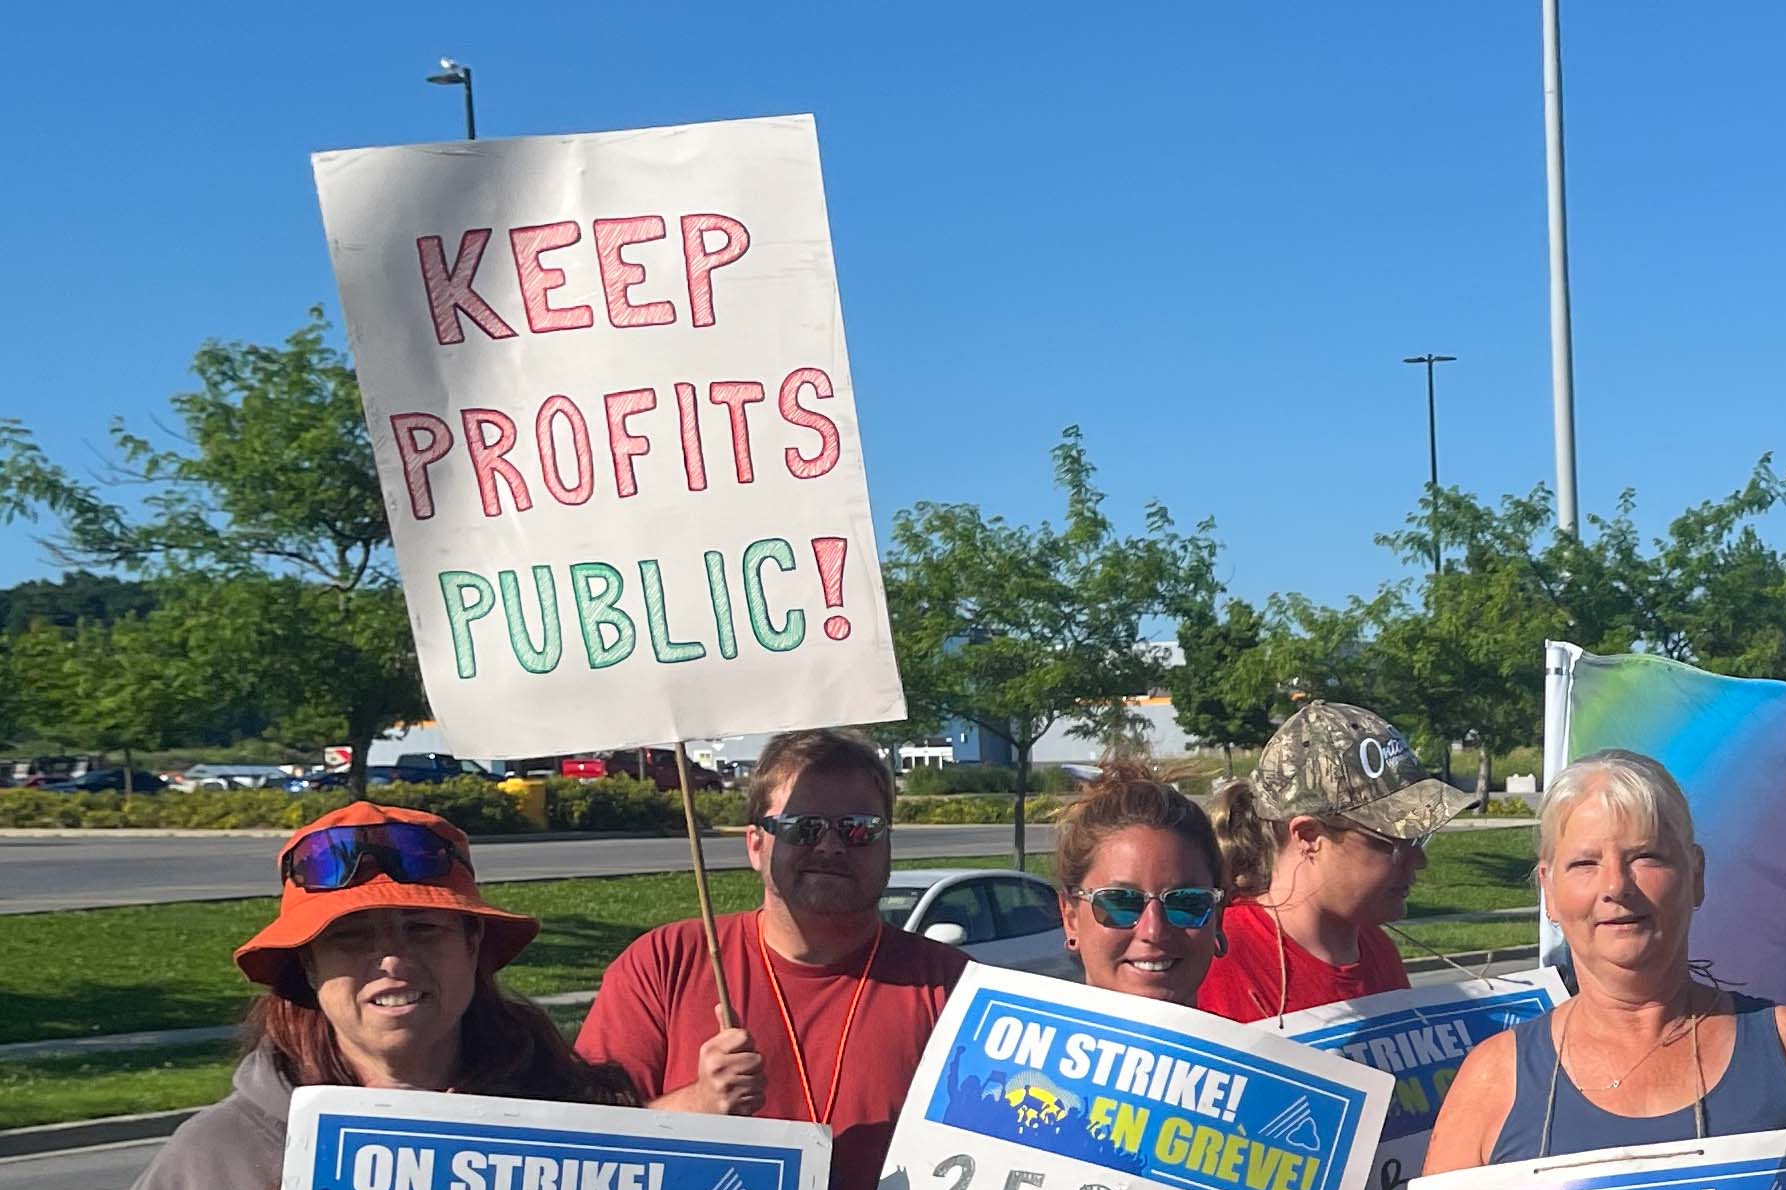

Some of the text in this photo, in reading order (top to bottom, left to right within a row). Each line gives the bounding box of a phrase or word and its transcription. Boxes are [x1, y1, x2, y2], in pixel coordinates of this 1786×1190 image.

[417, 214, 751, 345] KEEP
[390, 367, 840, 520] PROFITS
[439, 537, 852, 679] PUBLIC!
[984, 1016, 1249, 1123] ON STRIKE!
[1325, 1020, 1474, 1072] TRIKE!
[1088, 1096, 1150, 1154] EN
